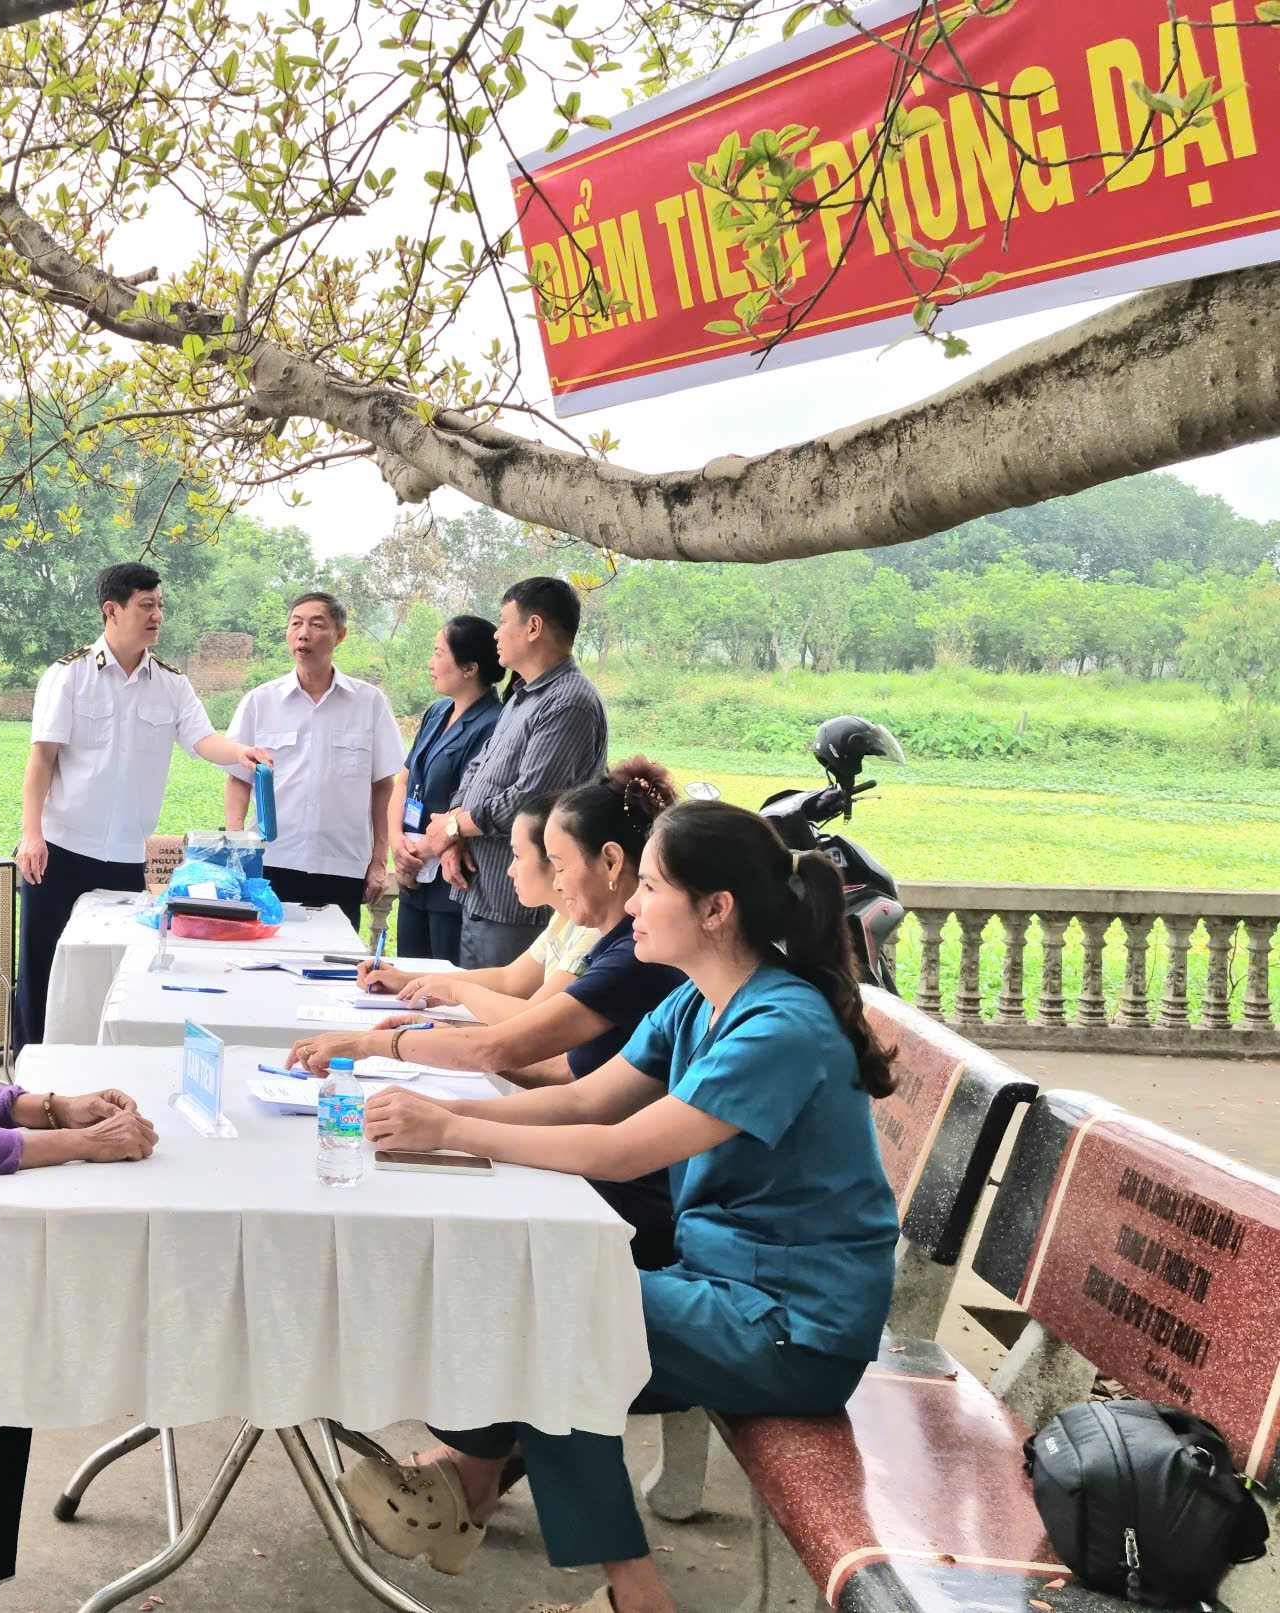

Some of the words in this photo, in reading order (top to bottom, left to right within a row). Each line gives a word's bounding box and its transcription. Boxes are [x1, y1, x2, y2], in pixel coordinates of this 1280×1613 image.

[530, 178, 658, 345] ĐIỂM
[809, 66, 1075, 269] PHÒNG
[1085, 0, 1257, 208] DẠI
